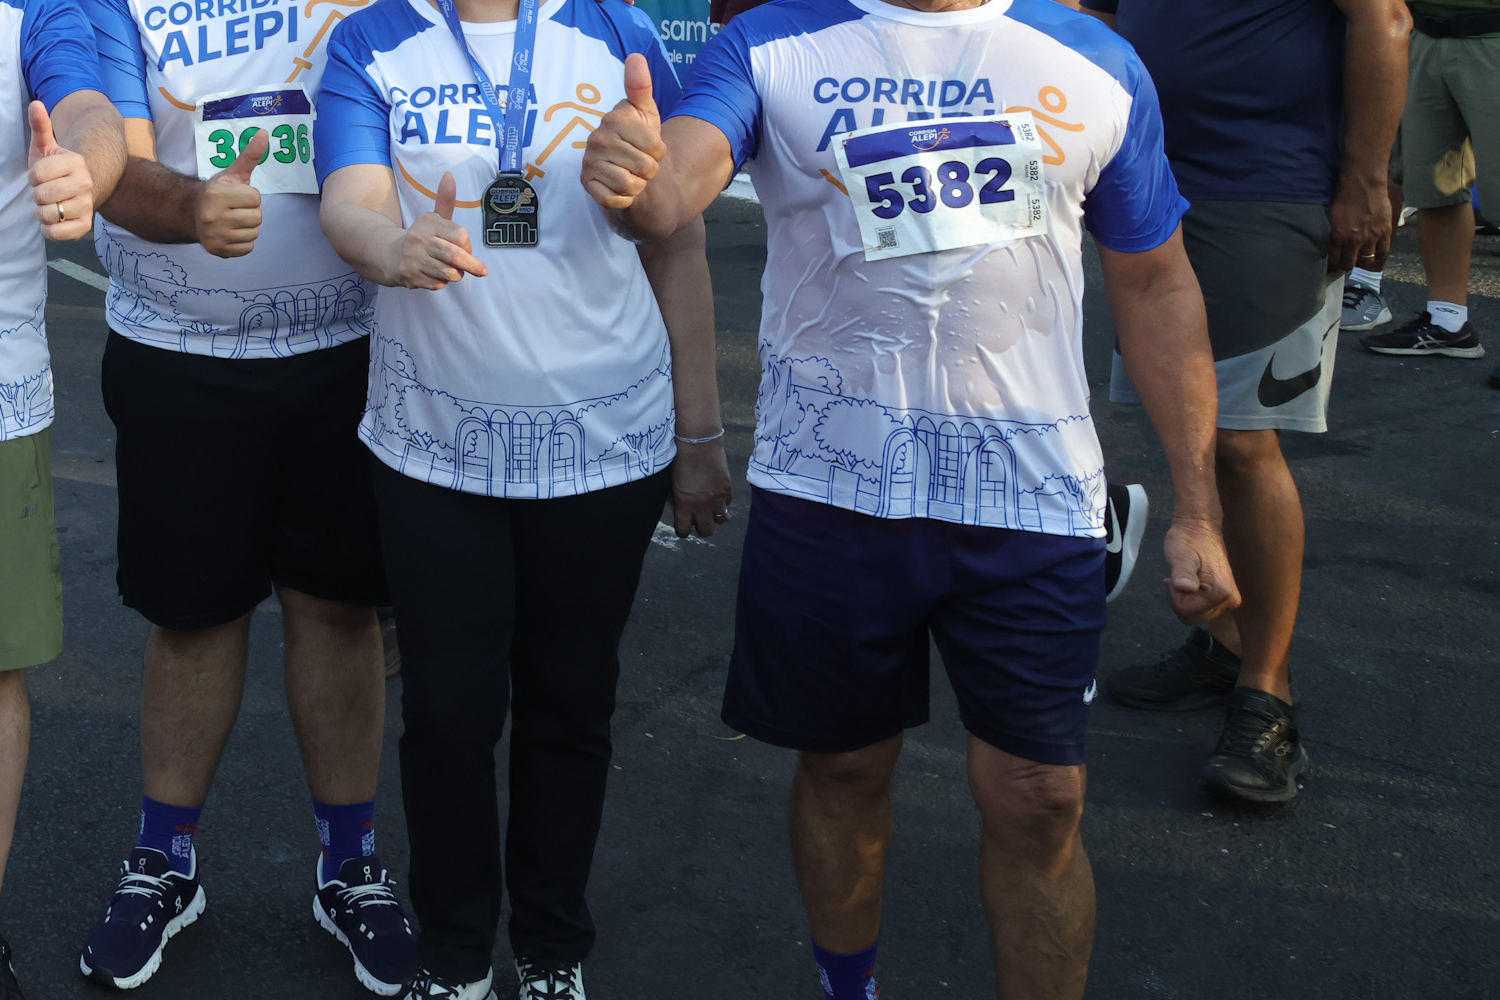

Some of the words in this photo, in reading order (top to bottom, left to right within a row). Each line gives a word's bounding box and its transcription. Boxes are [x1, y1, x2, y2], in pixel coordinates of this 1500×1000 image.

[157, 5, 298, 72] ALEPI
[390, 83, 538, 109] CORRA
[813, 77, 995, 108] CORRIDA
[252, 100, 273, 108] ALEPI
[396, 108, 538, 148] ALEI
[908, 128, 937, 137] CORRIDA
[911, 132, 938, 143] ALEPI
[1021, 123, 1035, 142] 5382
[1029, 160, 1039, 182] 5382
[864, 157, 1015, 220] 5382
[1032, 199, 1041, 221] 5382
